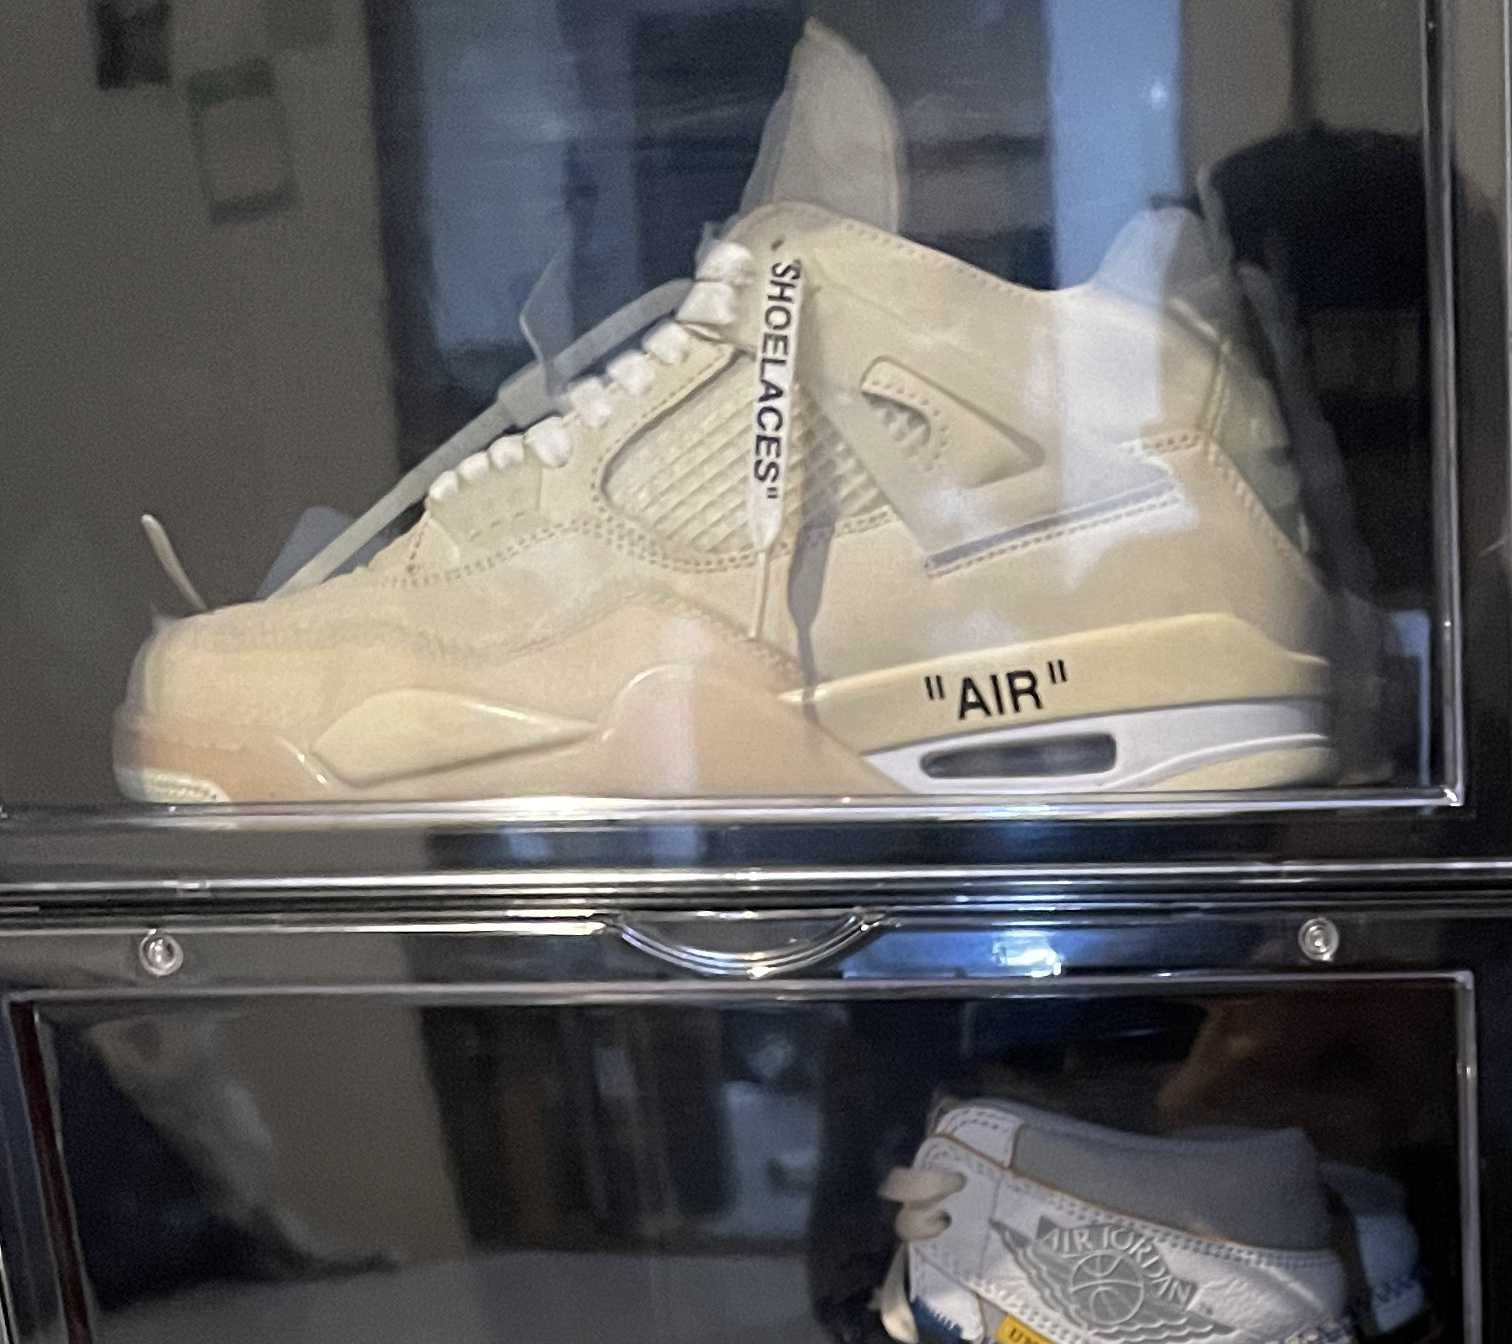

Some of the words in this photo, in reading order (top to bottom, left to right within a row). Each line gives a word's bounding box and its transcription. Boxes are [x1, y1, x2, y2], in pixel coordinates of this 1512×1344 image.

[924, 659, 1068, 720] "AIR"
[1038, 1227, 1092, 1252] AIR
[1101, 1227, 1199, 1311] JORDAN
